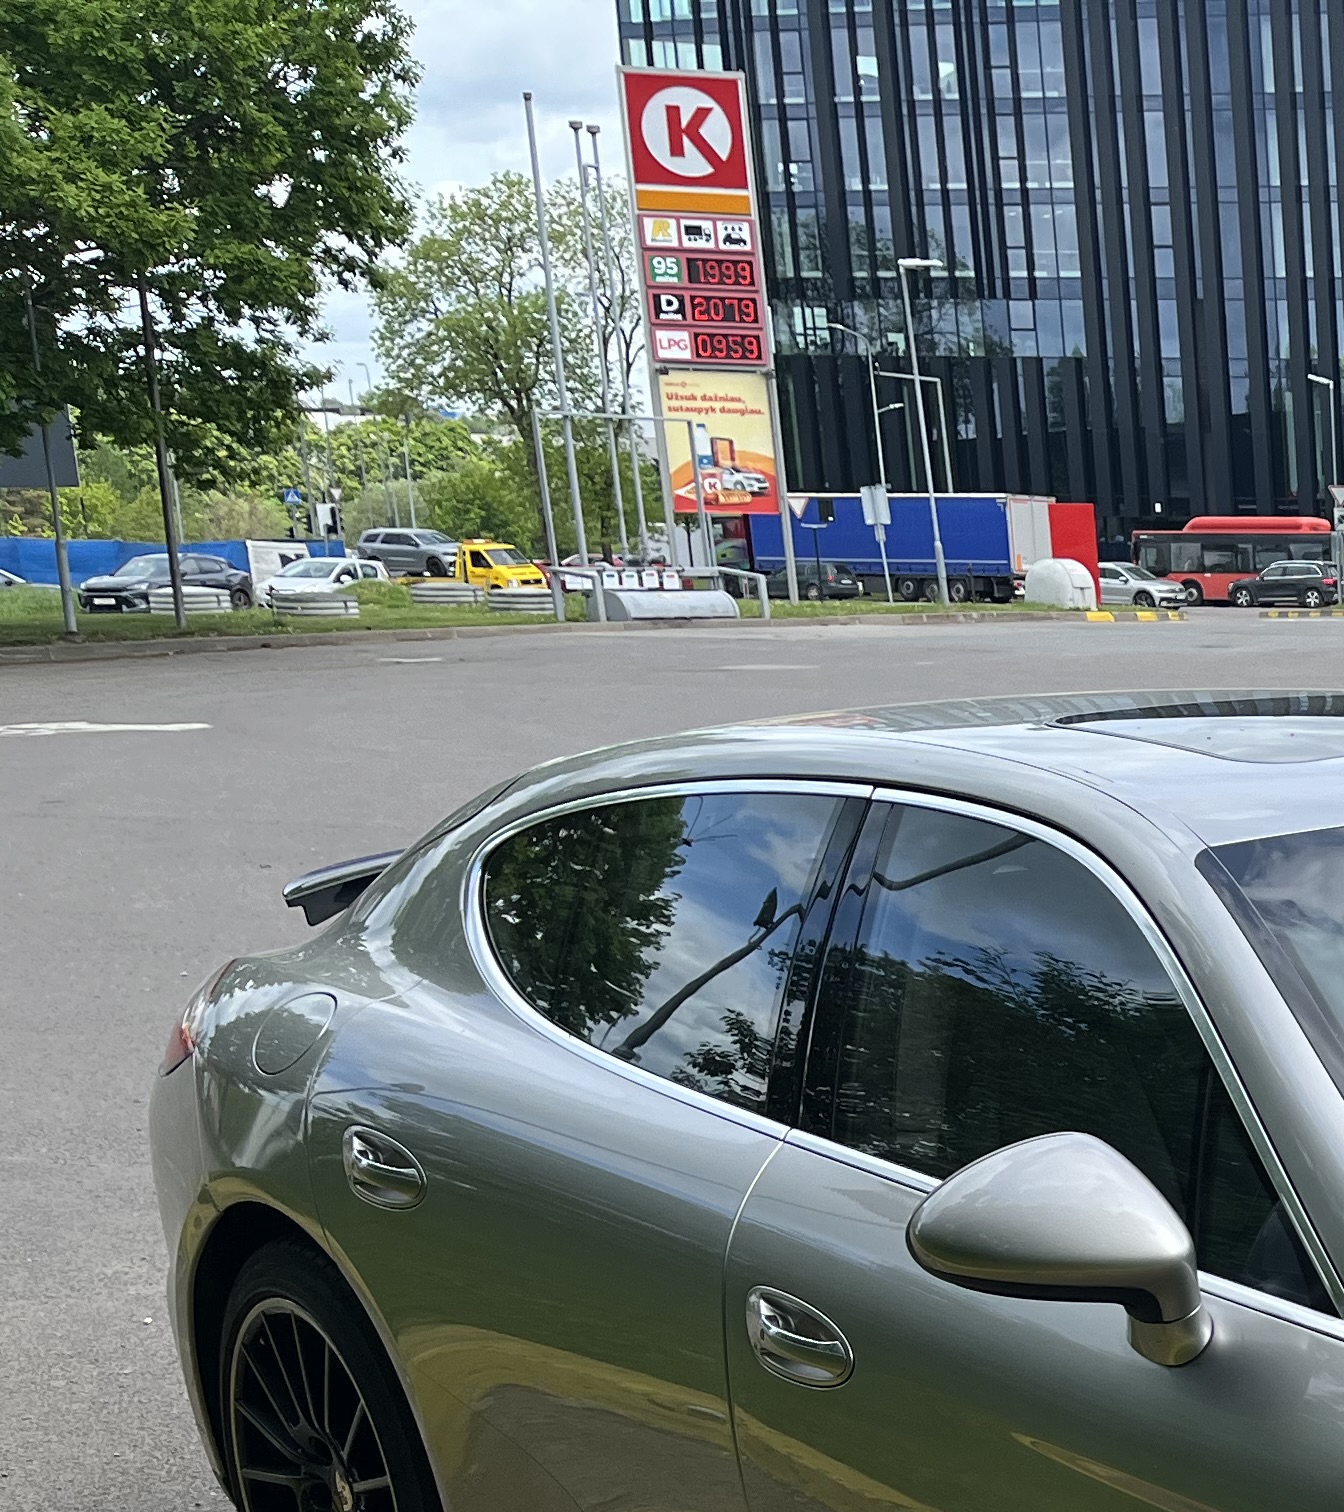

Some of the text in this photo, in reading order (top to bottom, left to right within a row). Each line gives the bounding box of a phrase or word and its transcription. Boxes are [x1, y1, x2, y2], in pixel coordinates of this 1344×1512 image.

[660, 100, 727, 174] K
[652, 257, 752, 285] 95 1999
[660, 294, 756, 323] D 2079
[658, 335, 759, 359] LPG 0959
